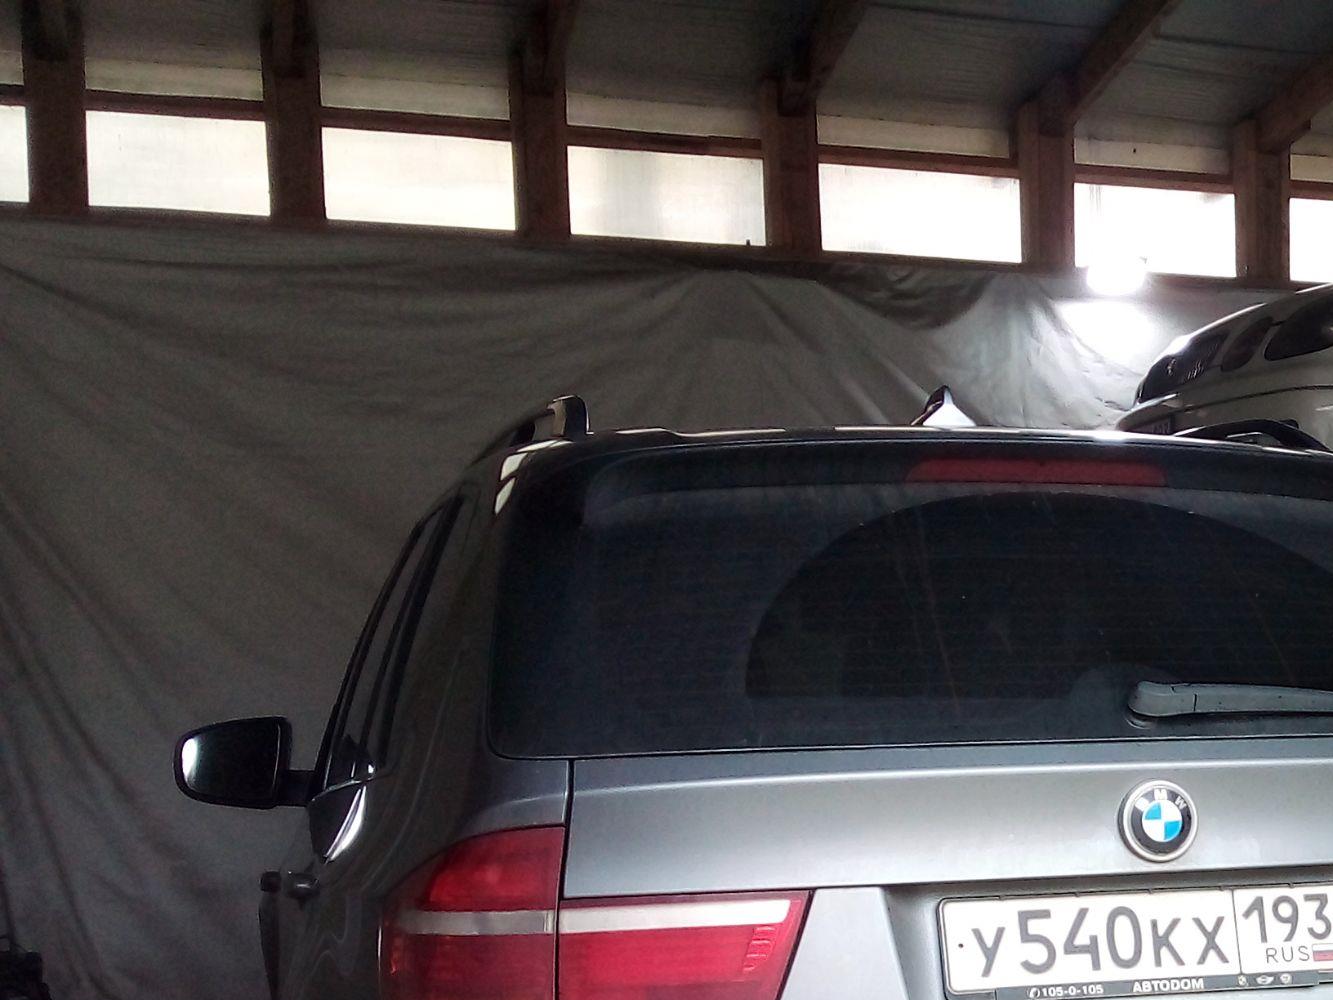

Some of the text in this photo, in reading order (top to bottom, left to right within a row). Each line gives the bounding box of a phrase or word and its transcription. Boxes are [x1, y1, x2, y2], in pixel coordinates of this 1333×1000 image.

[1134, 788, 1187, 811] BMW
[1242, 893, 1333, 943] 193
[1265, 945, 1310, 964] RUS
[1041, 984, 1104, 998] 105-0-105
